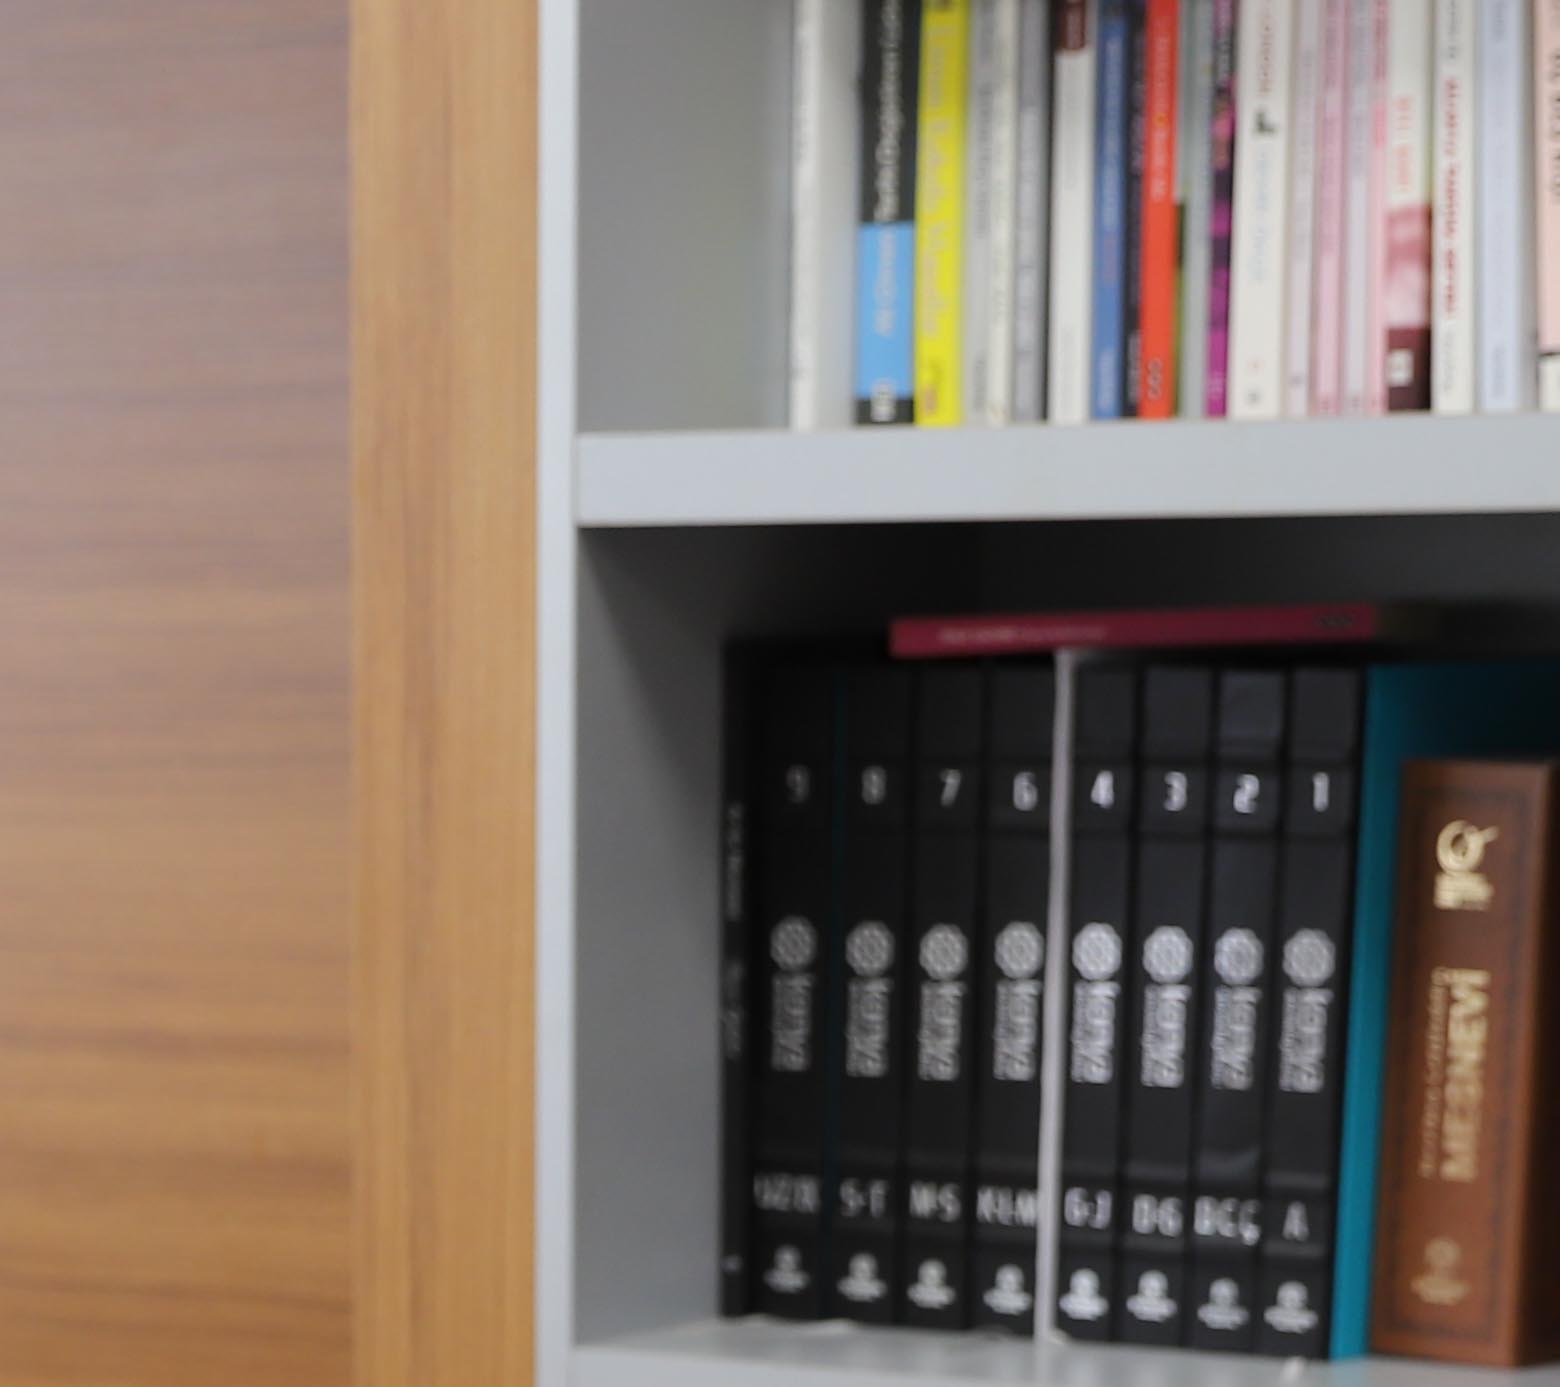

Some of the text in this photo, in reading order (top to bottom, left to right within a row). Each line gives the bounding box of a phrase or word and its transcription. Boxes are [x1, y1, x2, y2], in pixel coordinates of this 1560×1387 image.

[940, 768, 961, 807] 7
[1012, 771, 1038, 811] 6
[1091, 769, 1115, 809] 4
[1163, 771, 1187, 812] 3
[1233, 774, 1260, 814] 2
[1312, 772, 1330, 813] 1
